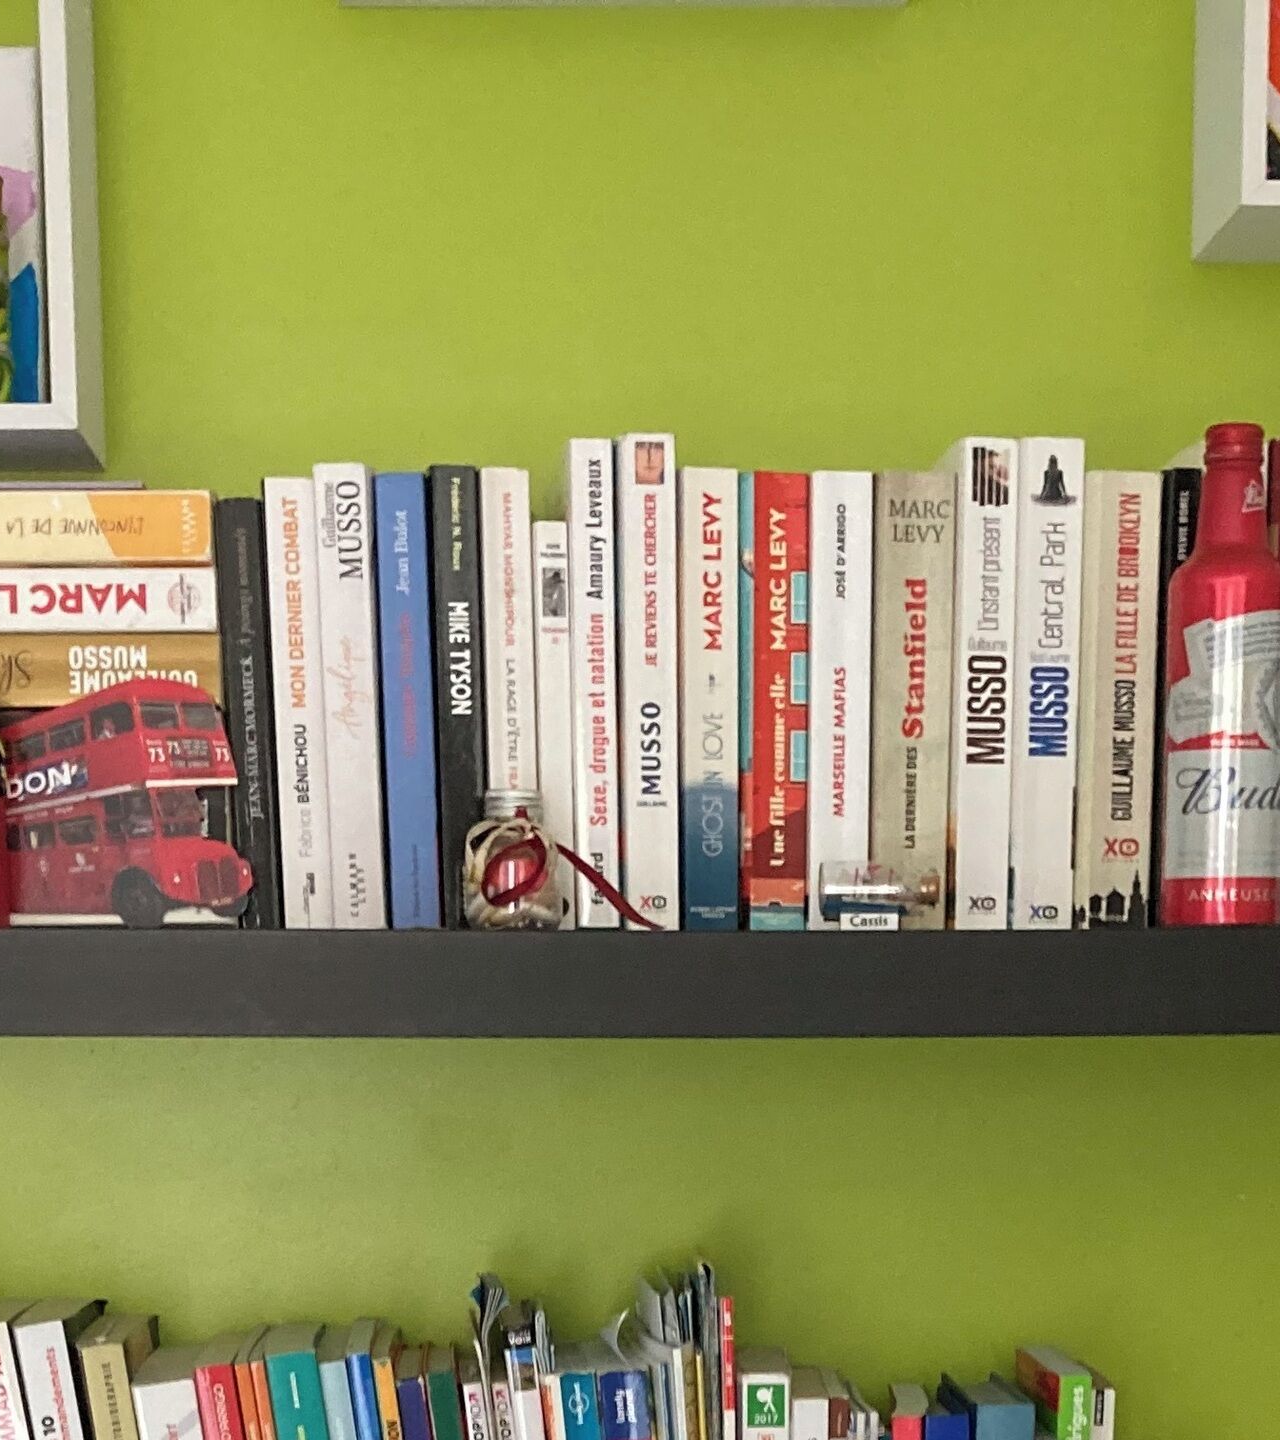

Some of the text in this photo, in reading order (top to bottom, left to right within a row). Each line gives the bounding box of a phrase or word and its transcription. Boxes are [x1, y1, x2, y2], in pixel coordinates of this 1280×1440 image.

[336, 480, 364, 581] MUSSO
[584, 458, 606, 600] Amaury Leveaux
[888, 499, 950, 519] MARC
[892, 525, 945, 544] LEVY
[30, 583, 147, 614] MARC
[282, 497, 306, 708] MON DERNIER COMBAT
[643, 494, 657, 648] REVIENS CHERCHER
[702, 492, 723, 650] MARC LEVY
[769, 507, 788, 649] MARC LEVY
[1037, 522, 1066, 649] Central Park
[70, 646, 147, 668] MUSSO
[448, 601, 471, 714] MIKE TYSON
[506, 679, 516, 713] RAGE
[901, 578, 928, 740] Stanfield
[966, 655, 1007, 765] MUSSO
[1111, 493, 1141, 821] GUILLAUME MUSSO LA FILLE DE BROOKLYN
[291, 723, 310, 803] BÉNICHOU
[587, 613, 612, 827] Sexe, drogue et natation
[640, 701, 661, 796] MUSSO
[832, 666, 846, 817] MARSEILLE MAFIAS
[1029, 666, 1069, 757] MUSSO
[702, 712, 723, 857] GHOST LOVE
[903, 747, 918, 849] LA DERNIÈRE DES
[850, 916, 888, 927] Cassis
[41, 1416, 56, 1436] 10
[754, 1413, 779, 1424] 2017
